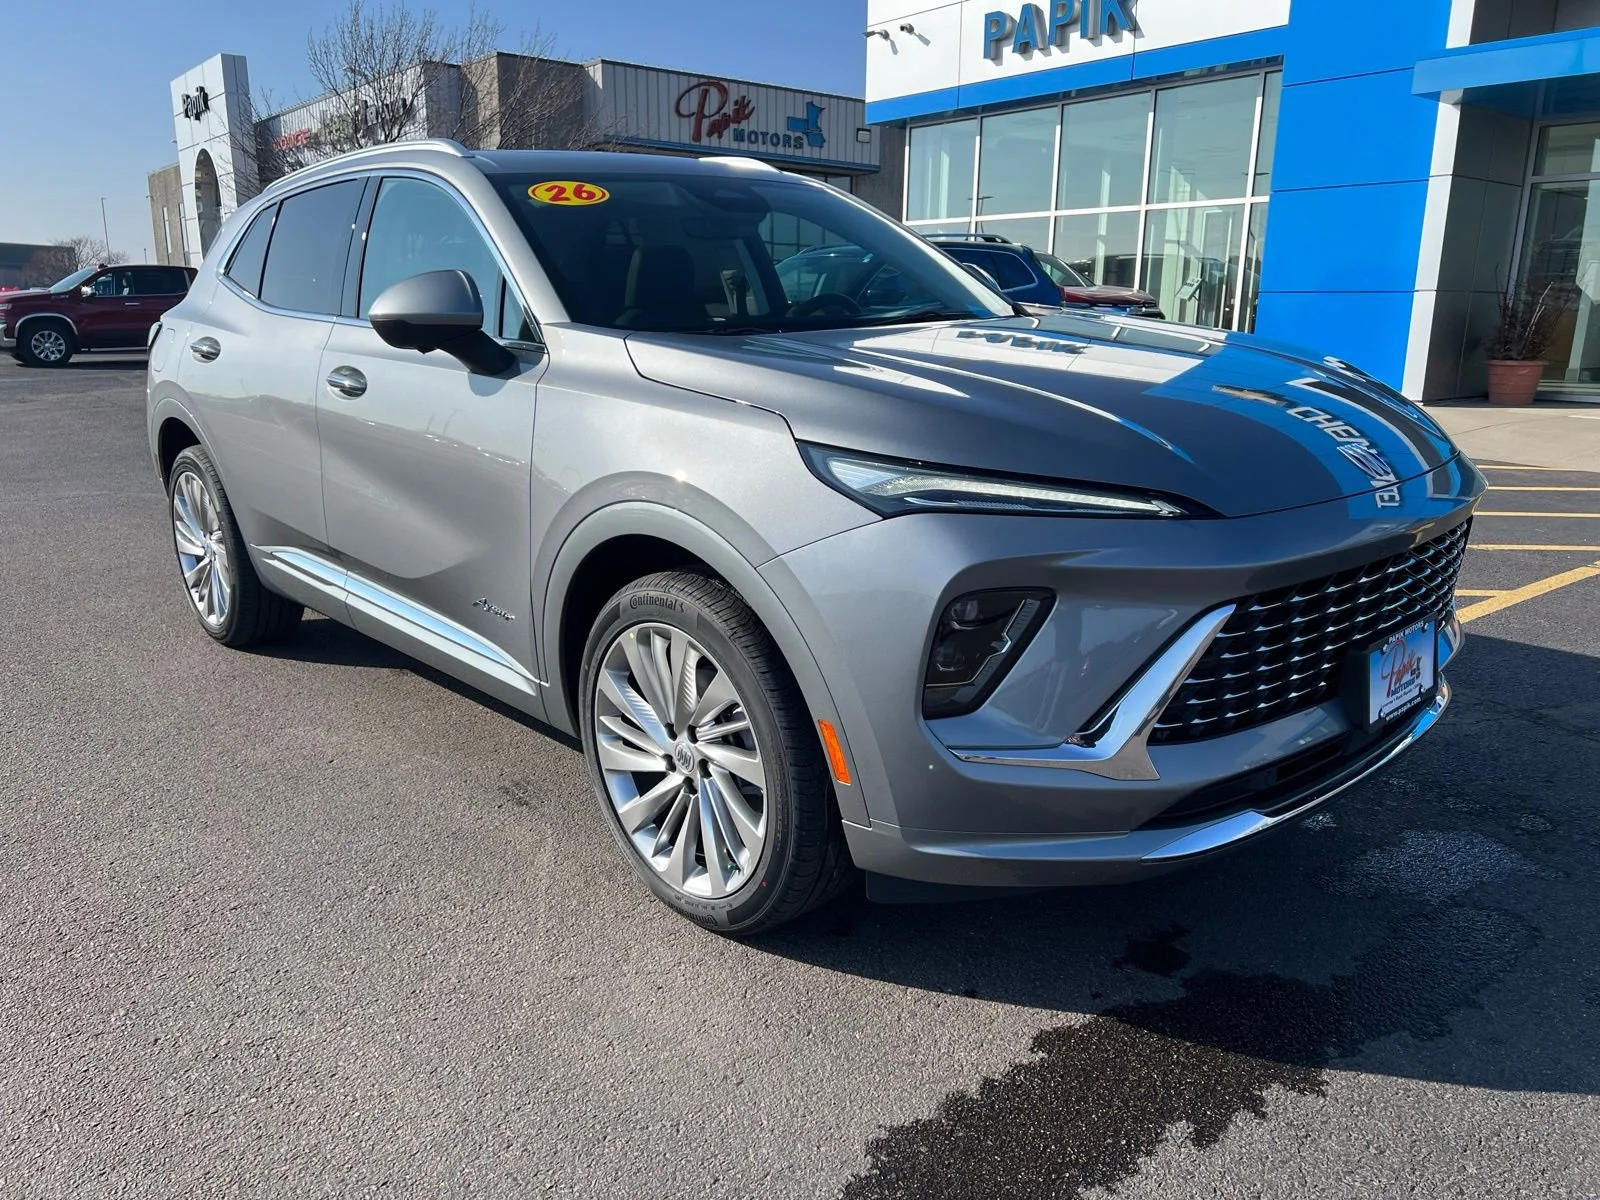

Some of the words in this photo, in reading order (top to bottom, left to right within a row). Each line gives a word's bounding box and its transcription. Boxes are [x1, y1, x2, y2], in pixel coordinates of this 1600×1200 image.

[983, 0, 1136, 59] PAPIK
[181, 86, 210, 121] Papik
[675, 81, 755, 142] Papik
[733, 127, 804, 150] MOTORS
[544, 183, 597, 203] 26
[629, 592, 678, 612] Continental
[1404, 620, 1424, 636] MOTORS
